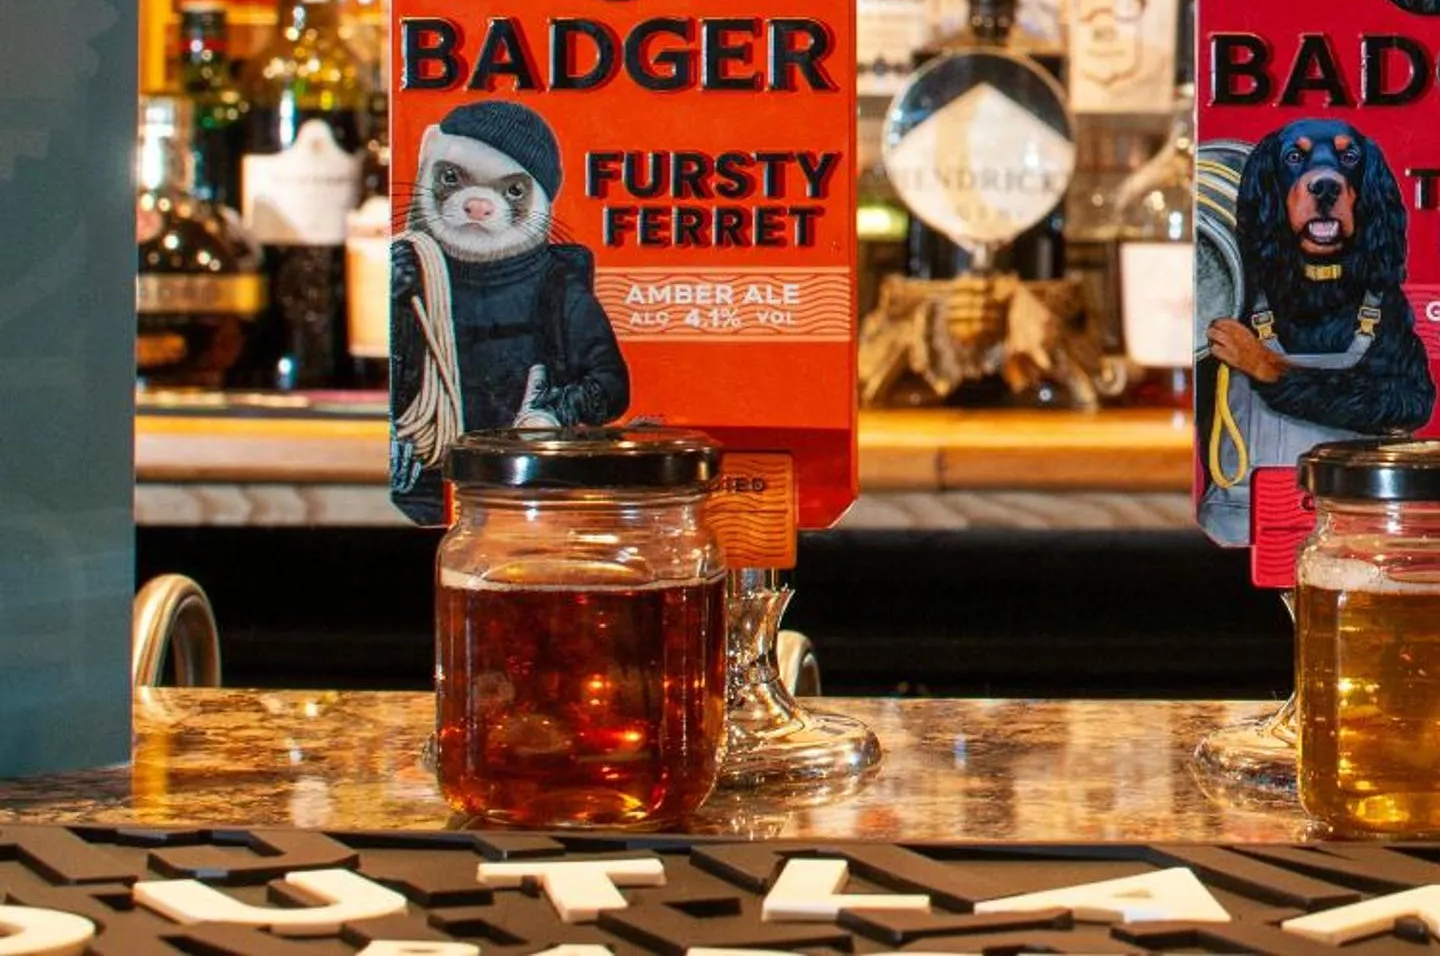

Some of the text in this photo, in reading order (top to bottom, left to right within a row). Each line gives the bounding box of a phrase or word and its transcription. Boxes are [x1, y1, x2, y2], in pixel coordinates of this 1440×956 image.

[400, 16, 839, 93] BADGER
[585, 150, 844, 201] FURSTY
[602, 204, 826, 249] FERRET
[625, 282, 801, 306] AMBER ALE
[629, 308, 797, 330] ALC 4.1% VOL
